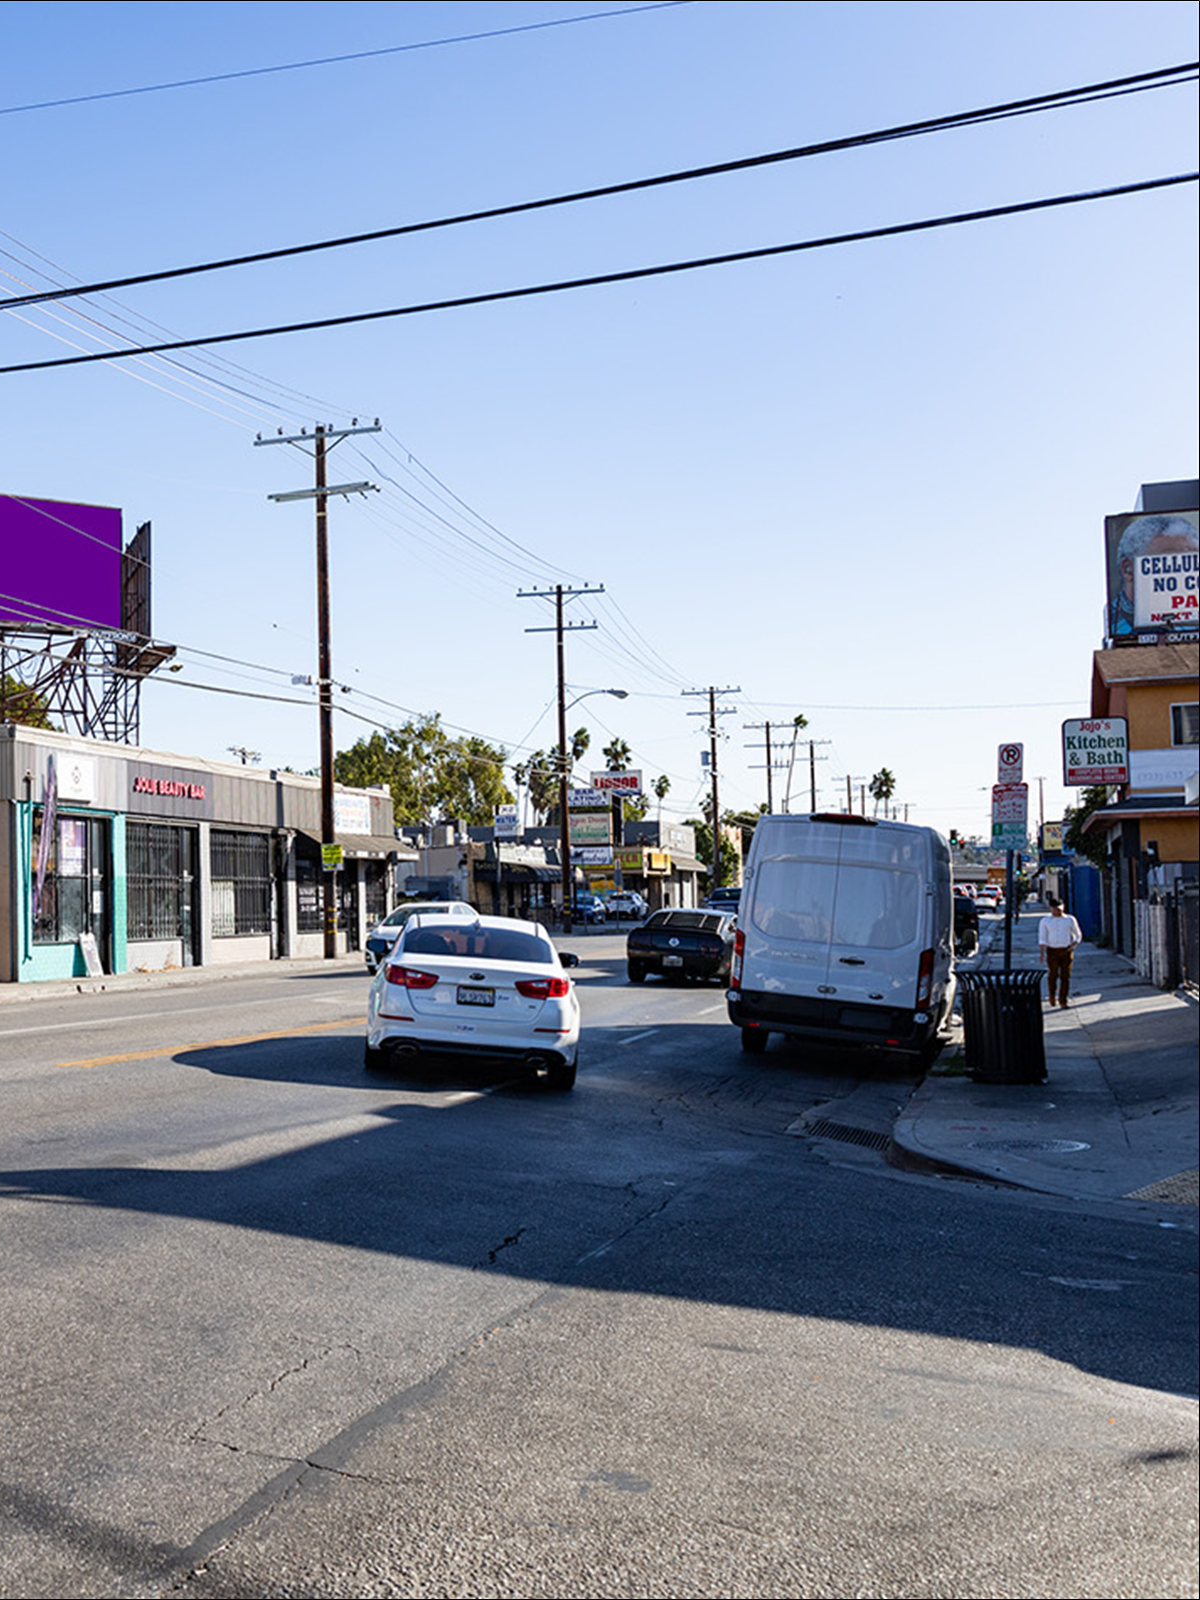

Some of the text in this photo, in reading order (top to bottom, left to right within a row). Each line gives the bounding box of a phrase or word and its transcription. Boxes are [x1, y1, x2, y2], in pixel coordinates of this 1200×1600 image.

[1154, 576, 1199, 592] NO C
[1080, 720, 1111, 733] Jojo's
[1066, 735, 1125, 750] Kitchen
[1069, 750, 1123, 766] & Bath
[133, 777, 206, 800] JOLIE BEAUTY BAR
[594, 776, 639, 789] LIQUOR
